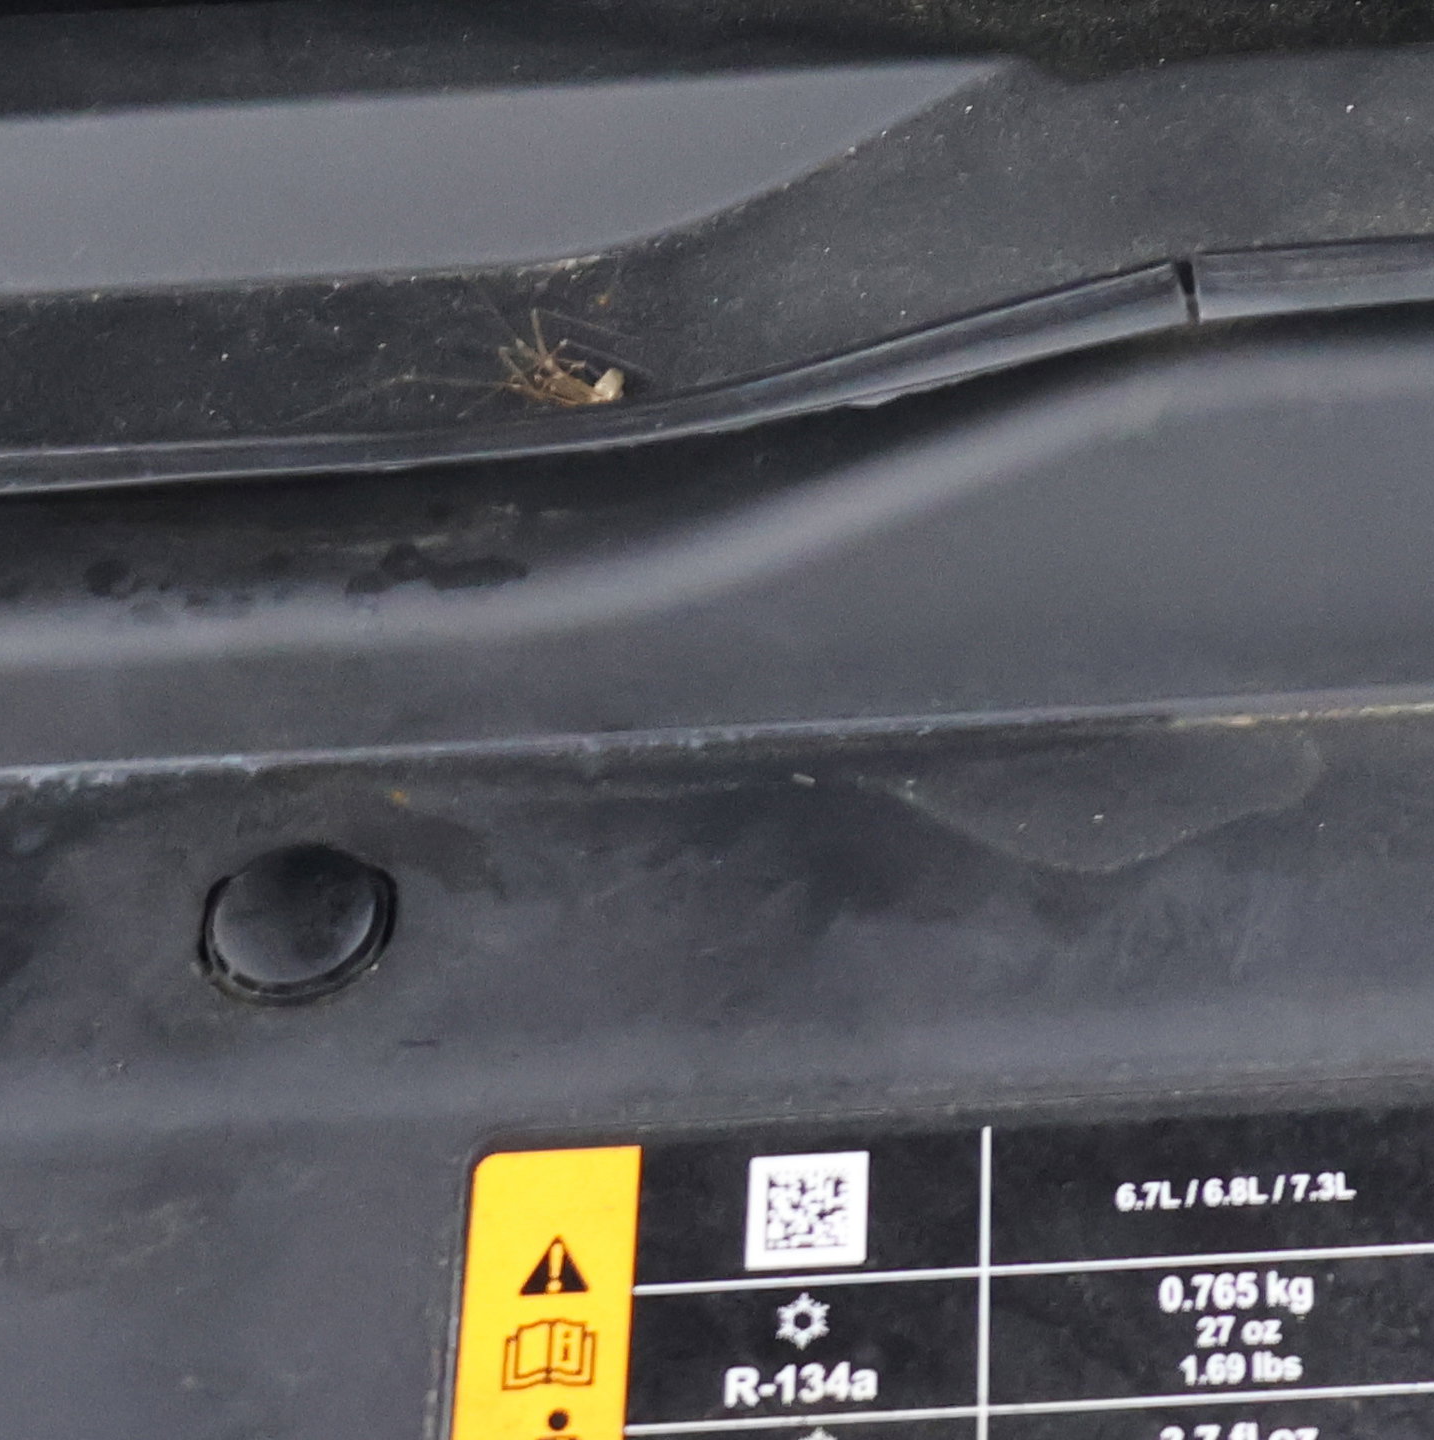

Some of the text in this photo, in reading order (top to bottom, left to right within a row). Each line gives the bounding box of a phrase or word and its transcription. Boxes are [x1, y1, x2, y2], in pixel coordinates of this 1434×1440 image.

[1115, 1171, 1357, 1212] 6.7L / 6.8L / 7.3L
[1158, 1270, 1315, 1315] 0.765 kg
[1195, 1315, 1283, 1349] 27 oz
[723, 1361, 878, 1409] R-134a
[1179, 1350, 1304, 1386] 1.69 lbs
